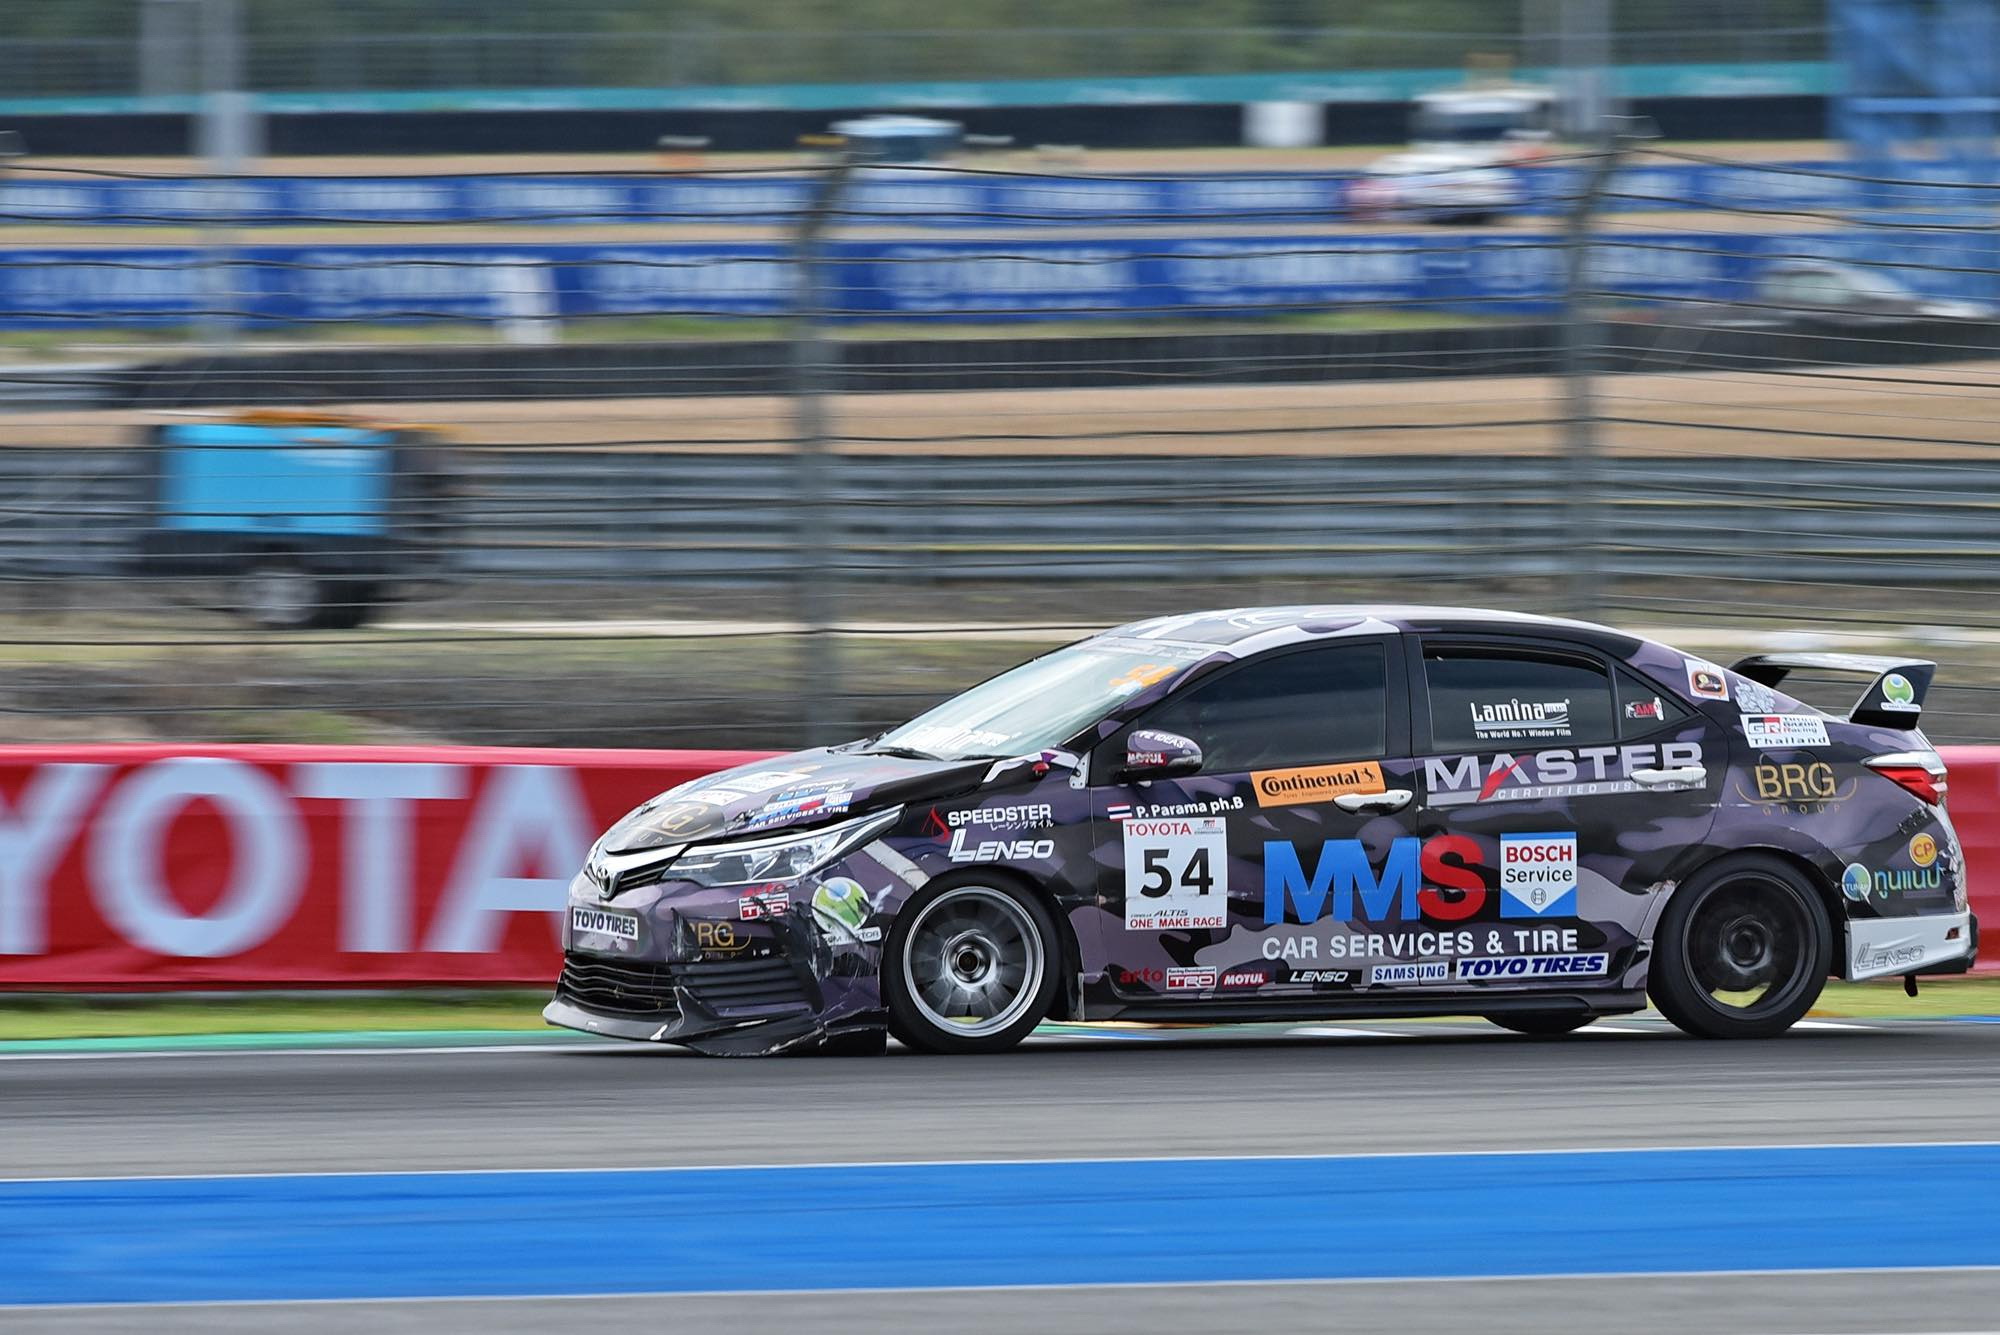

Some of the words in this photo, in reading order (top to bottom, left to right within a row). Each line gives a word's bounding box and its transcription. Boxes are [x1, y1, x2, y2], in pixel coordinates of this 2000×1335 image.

[1470, 698, 1545, 722] Lamina
[1475, 731, 1489, 739] The
[1490, 730, 1510, 739] World
[1511, 729, 1527, 738] No.1
[1528, 729, 1555, 738] Window
[1556, 728, 1571, 737] Film
[1752, 737, 1826, 745] Thailand
[1260, 769, 1362, 796] Continental
[1754, 762, 1836, 799] BRG
[1498, 784, 1597, 800] CERTIFIED
[948, 804, 1052, 827] SPEEDSTER
[1136, 806, 1149, 818] P.
[1151, 803, 1208, 817] Parama
[1126, 823, 1192, 836] TOYOTA
[948, 829, 1055, 862] LENSO
[1506, 845, 1573, 863] BOSCH
[1914, 842, 1933, 858] CP
[1140, 848, 1214, 898] 54
[1263, 834, 1487, 924] MMS
[1505, 866, 1573, 883] Service
[1153, 909, 1189, 917] ALTIS
[575, 910, 605, 930] TOYO
[606, 915, 636, 936] TIRES
[1130, 919, 1154, 928] ONE
[1158, 918, 1190, 927] MAKE
[1193, 917, 1223, 926] RACE
[690, 921, 735, 947] RG
[1262, 936, 1318, 960] CAR
[1330, 931, 1474, 959] SERVICES
[1486, 930, 1504, 953] &
[1513, 929, 1578, 953] TIRE
[1374, 965, 1446, 981] SAMSUNG
[1460, 957, 1528, 978] TOYO
[1531, 955, 1605, 974] TIRES
[1169, 975, 1213, 989] TRD
[1223, 973, 1264, 986] MOTUL
[1290, 971, 1349, 983] LENSO
